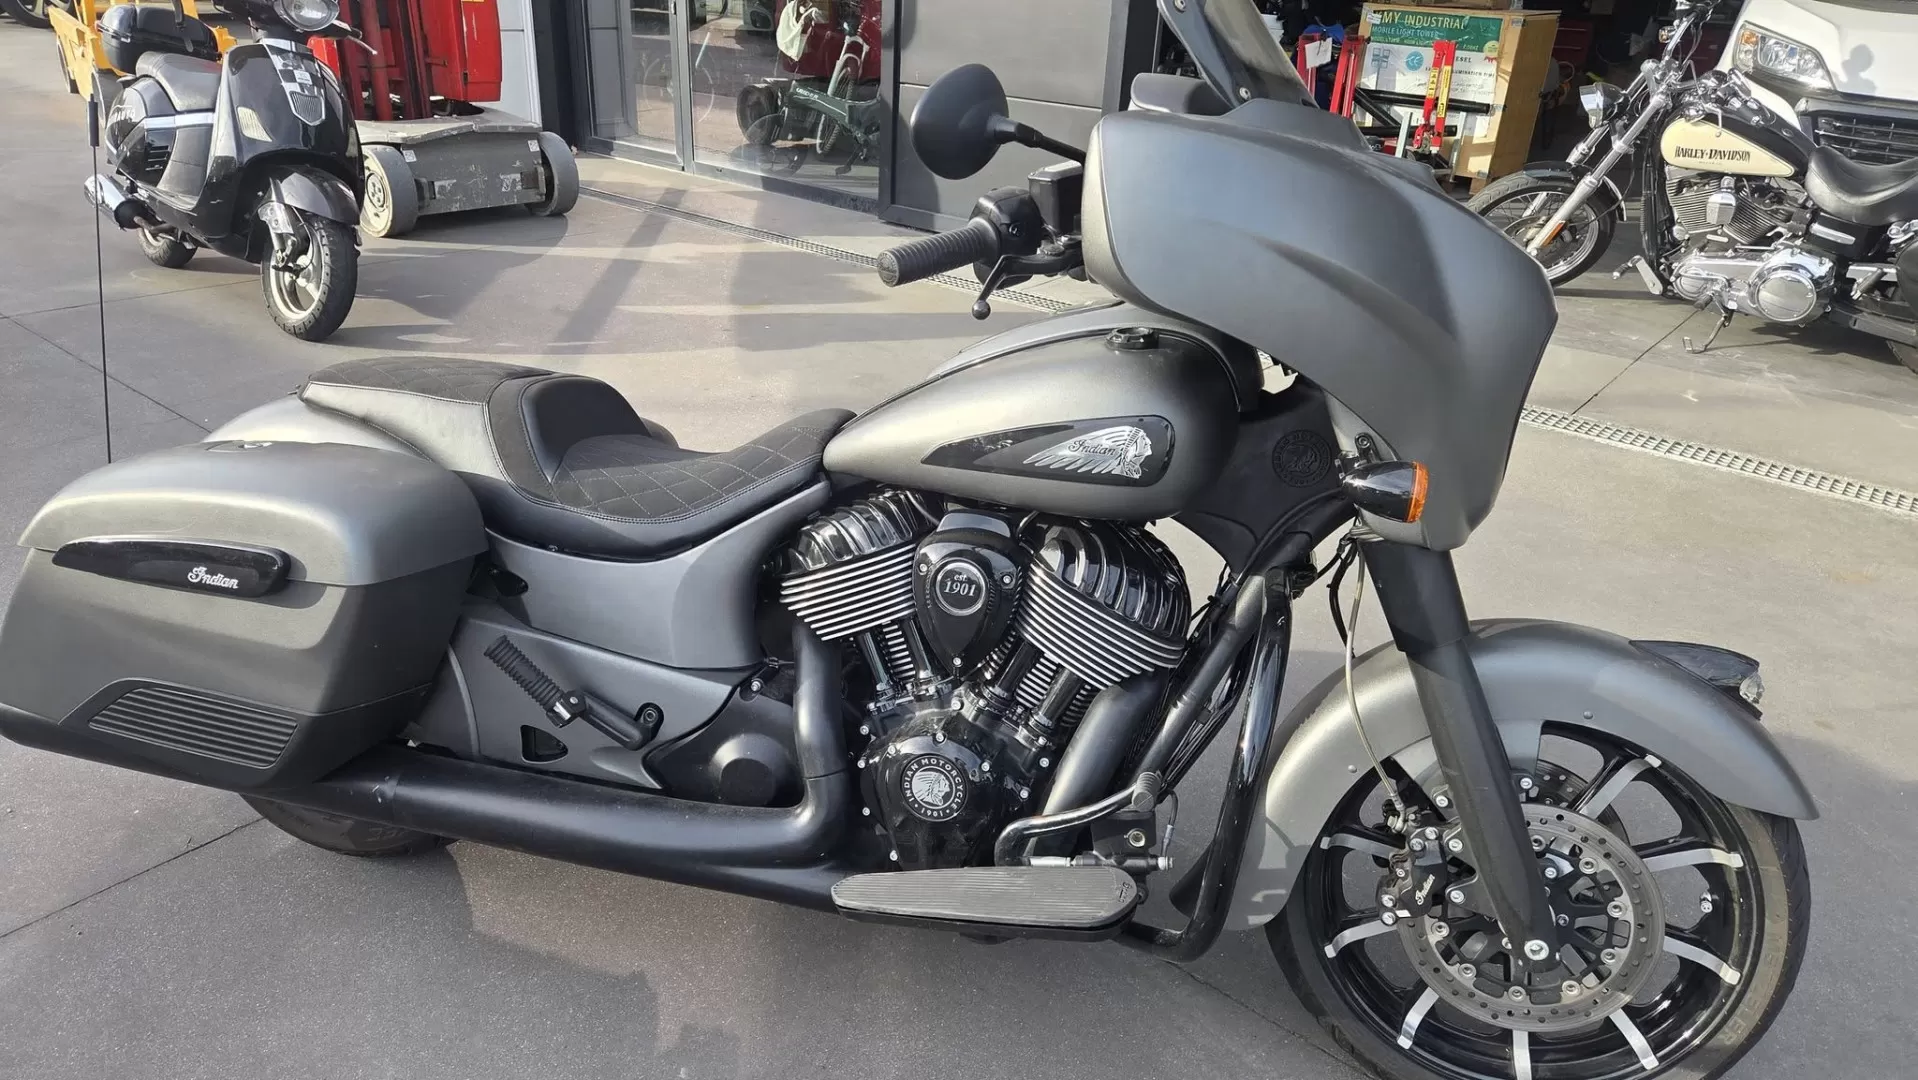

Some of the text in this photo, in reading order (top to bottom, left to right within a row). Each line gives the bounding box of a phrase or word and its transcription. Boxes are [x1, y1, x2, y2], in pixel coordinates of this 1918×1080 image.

[1455, 55, 1472, 63] ESEL
[1068, 439, 1116, 455] Indian
[187, 566, 239, 589] Indian
[943, 580, 976, 597] 1901
[904, 758, 964, 810] INDIAN MOTORCYCLE
[921, 807, 943, 817] 1901
[1415, 874, 1435, 905] Indian
